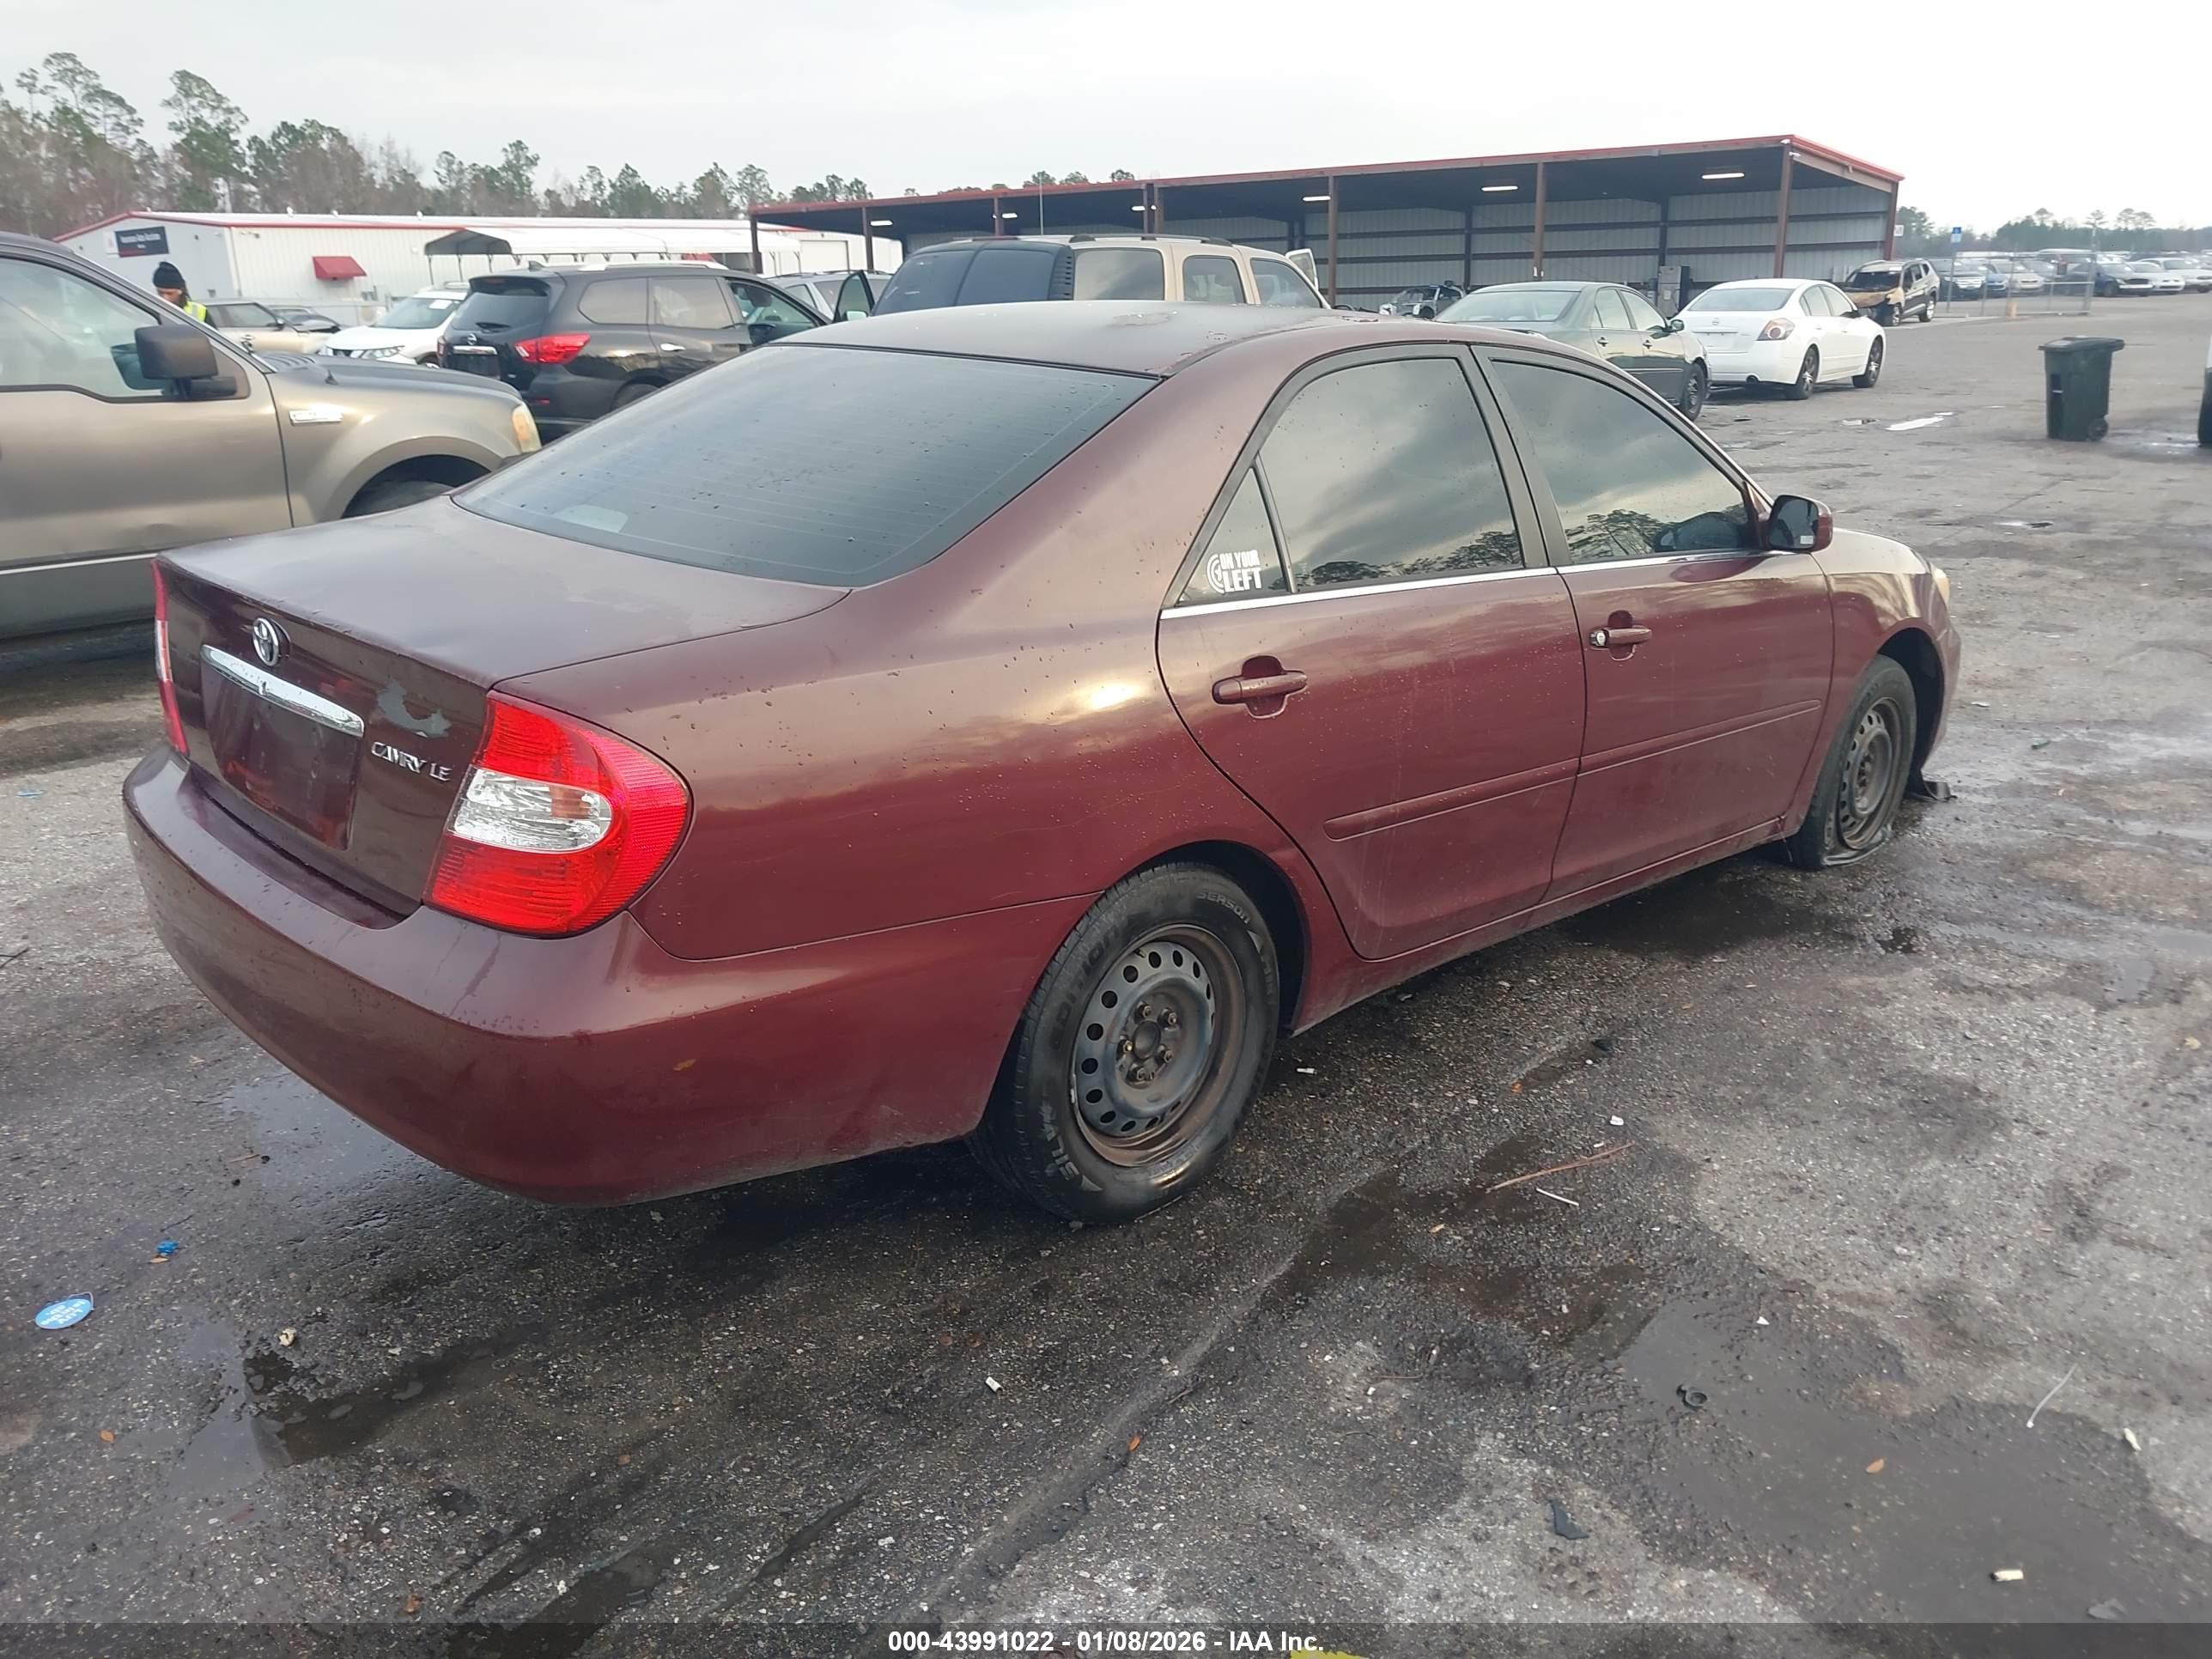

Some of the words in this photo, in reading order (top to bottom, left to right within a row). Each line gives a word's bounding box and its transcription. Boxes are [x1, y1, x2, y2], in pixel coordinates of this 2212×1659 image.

[1233, 550, 1261, 568] YOUR
[1222, 567, 1262, 592] LEFT
[371, 741, 428, 774] CAMRY
[429, 763, 453, 781] LE
